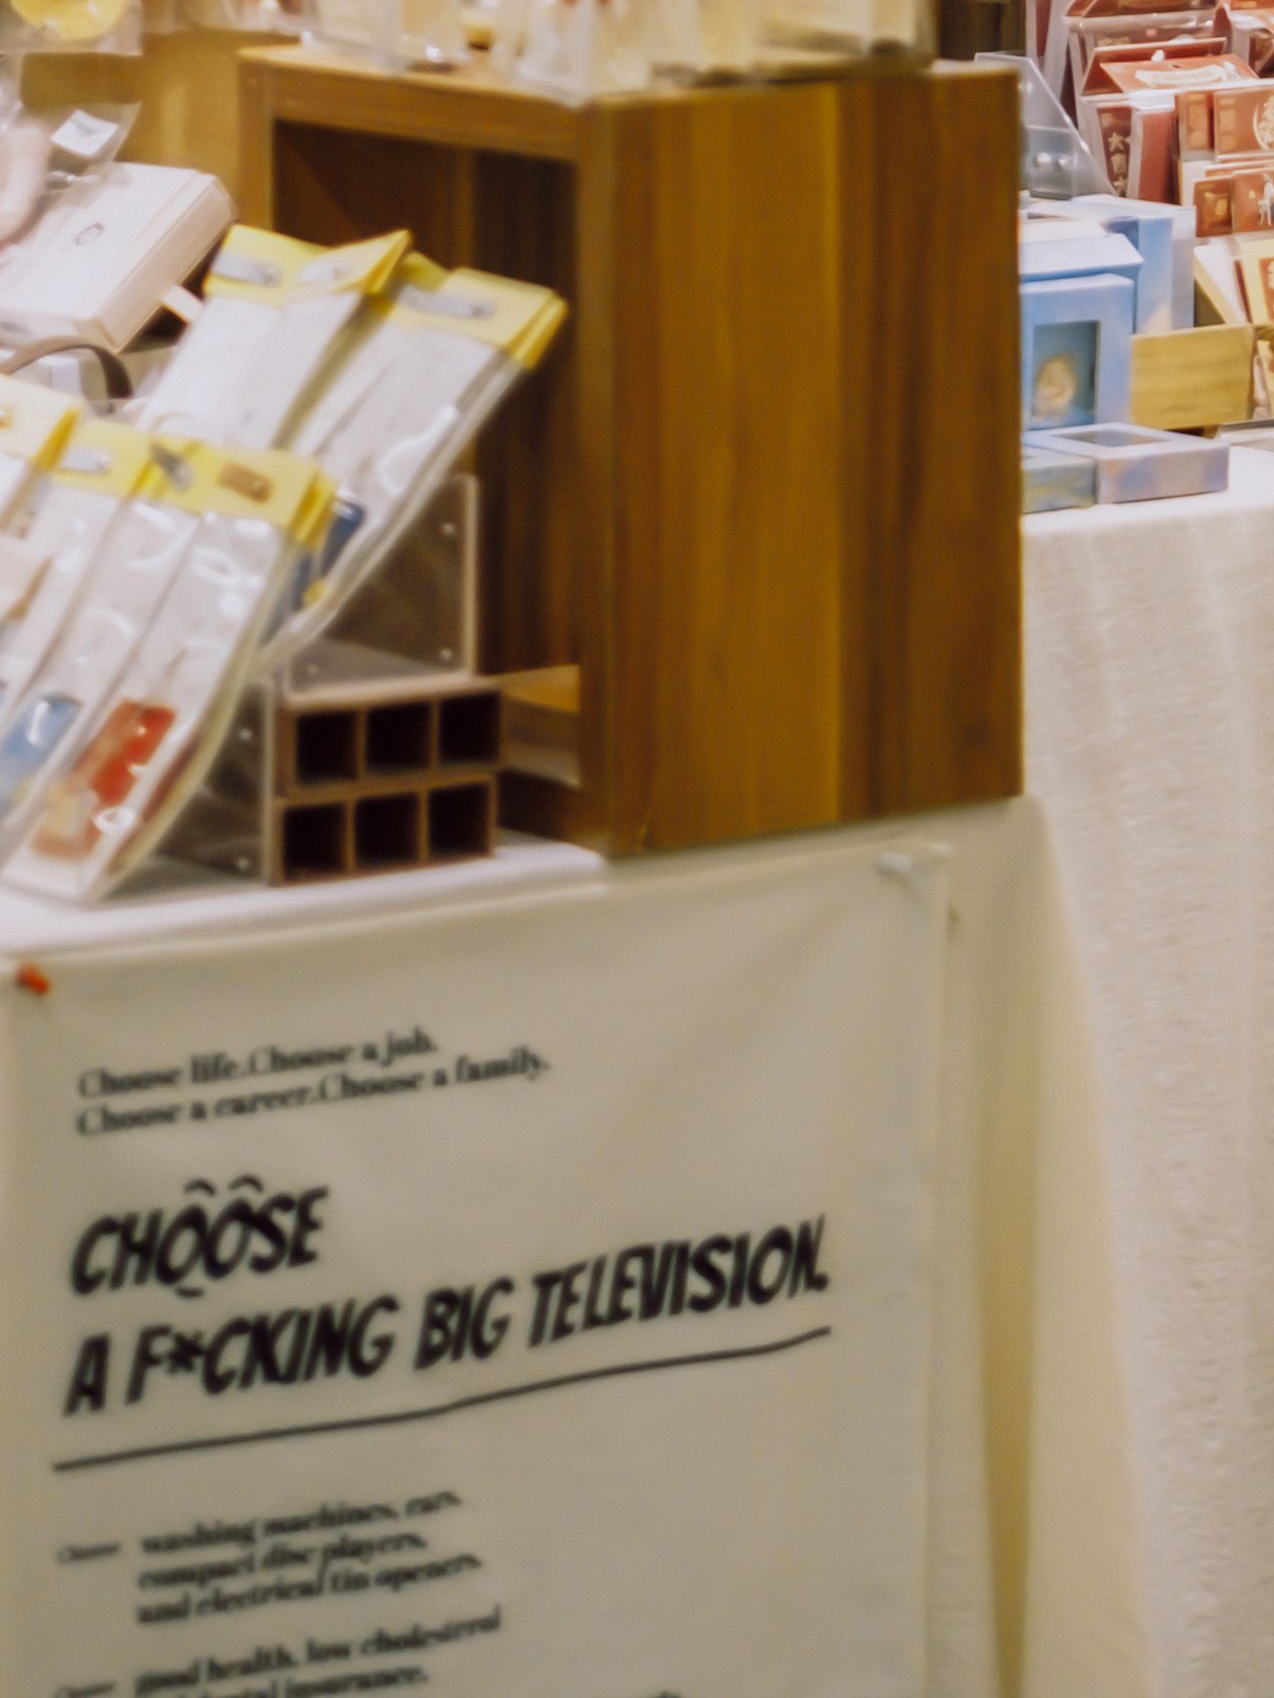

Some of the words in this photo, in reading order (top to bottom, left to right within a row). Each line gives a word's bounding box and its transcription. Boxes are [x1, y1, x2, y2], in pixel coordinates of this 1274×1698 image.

[77, 1065, 183, 1101] Choose
[76, 1100, 183, 1138] Choose
[65, 1333, 111, 1416] A
[414, 1276, 515, 1372] BIG
[527, 1214, 831, 1349] TELEVISION.
